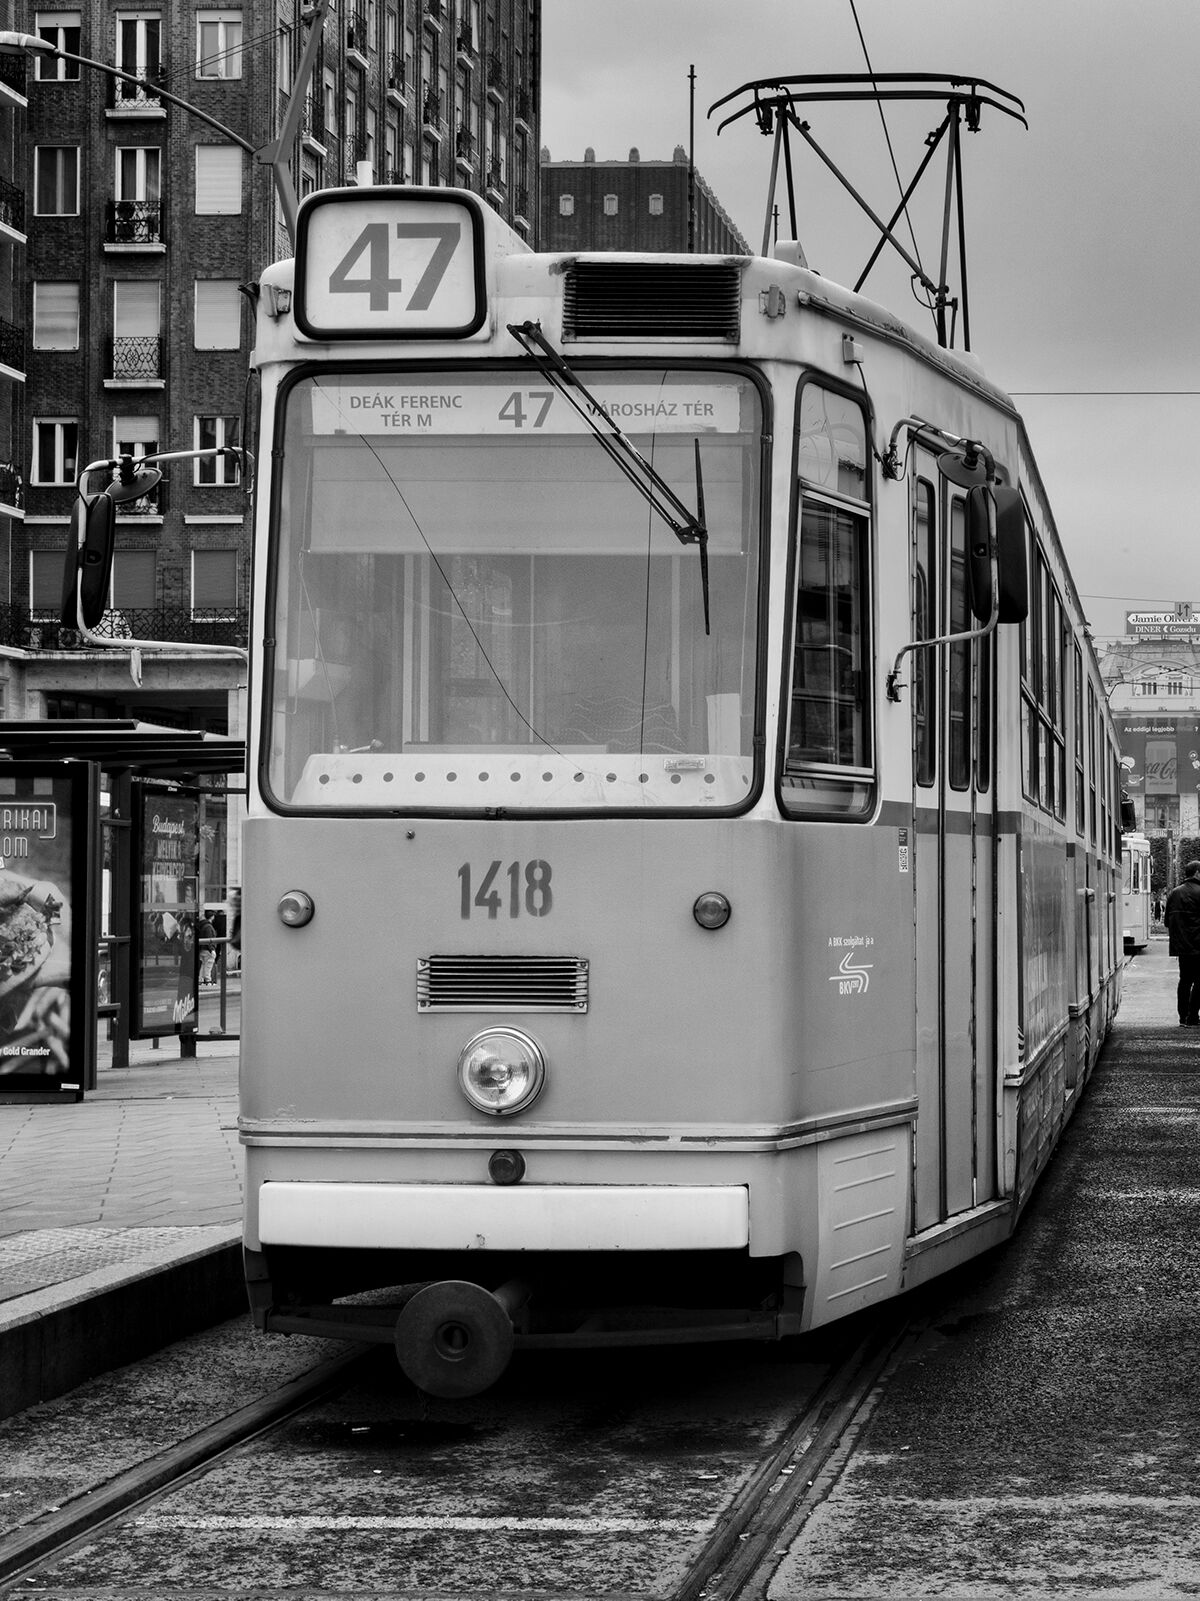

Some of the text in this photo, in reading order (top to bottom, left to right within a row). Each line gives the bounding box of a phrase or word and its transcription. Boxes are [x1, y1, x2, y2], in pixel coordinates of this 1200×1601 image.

[329, 222, 461, 312] 47
[350, 391, 463, 410] DEÁK FERENC
[586, 398, 715, 417] VÁROSHÁZ TÉR
[381, 410, 433, 427] TÉR M
[498, 391, 555, 429] 47
[1132, 615, 1162, 624] Jamie
[1135, 625, 1197, 633] DINER Gozsdu
[3, 836, 28, 858] OM
[457, 859, 553, 921] 1418
[828, 938, 832, 946] A
[833, 936, 843, 947] BKK
[840, 981, 852, 994] BKV
[3, 1046, 20, 1056] Gold
[21, 1046, 51, 1056] Grander
